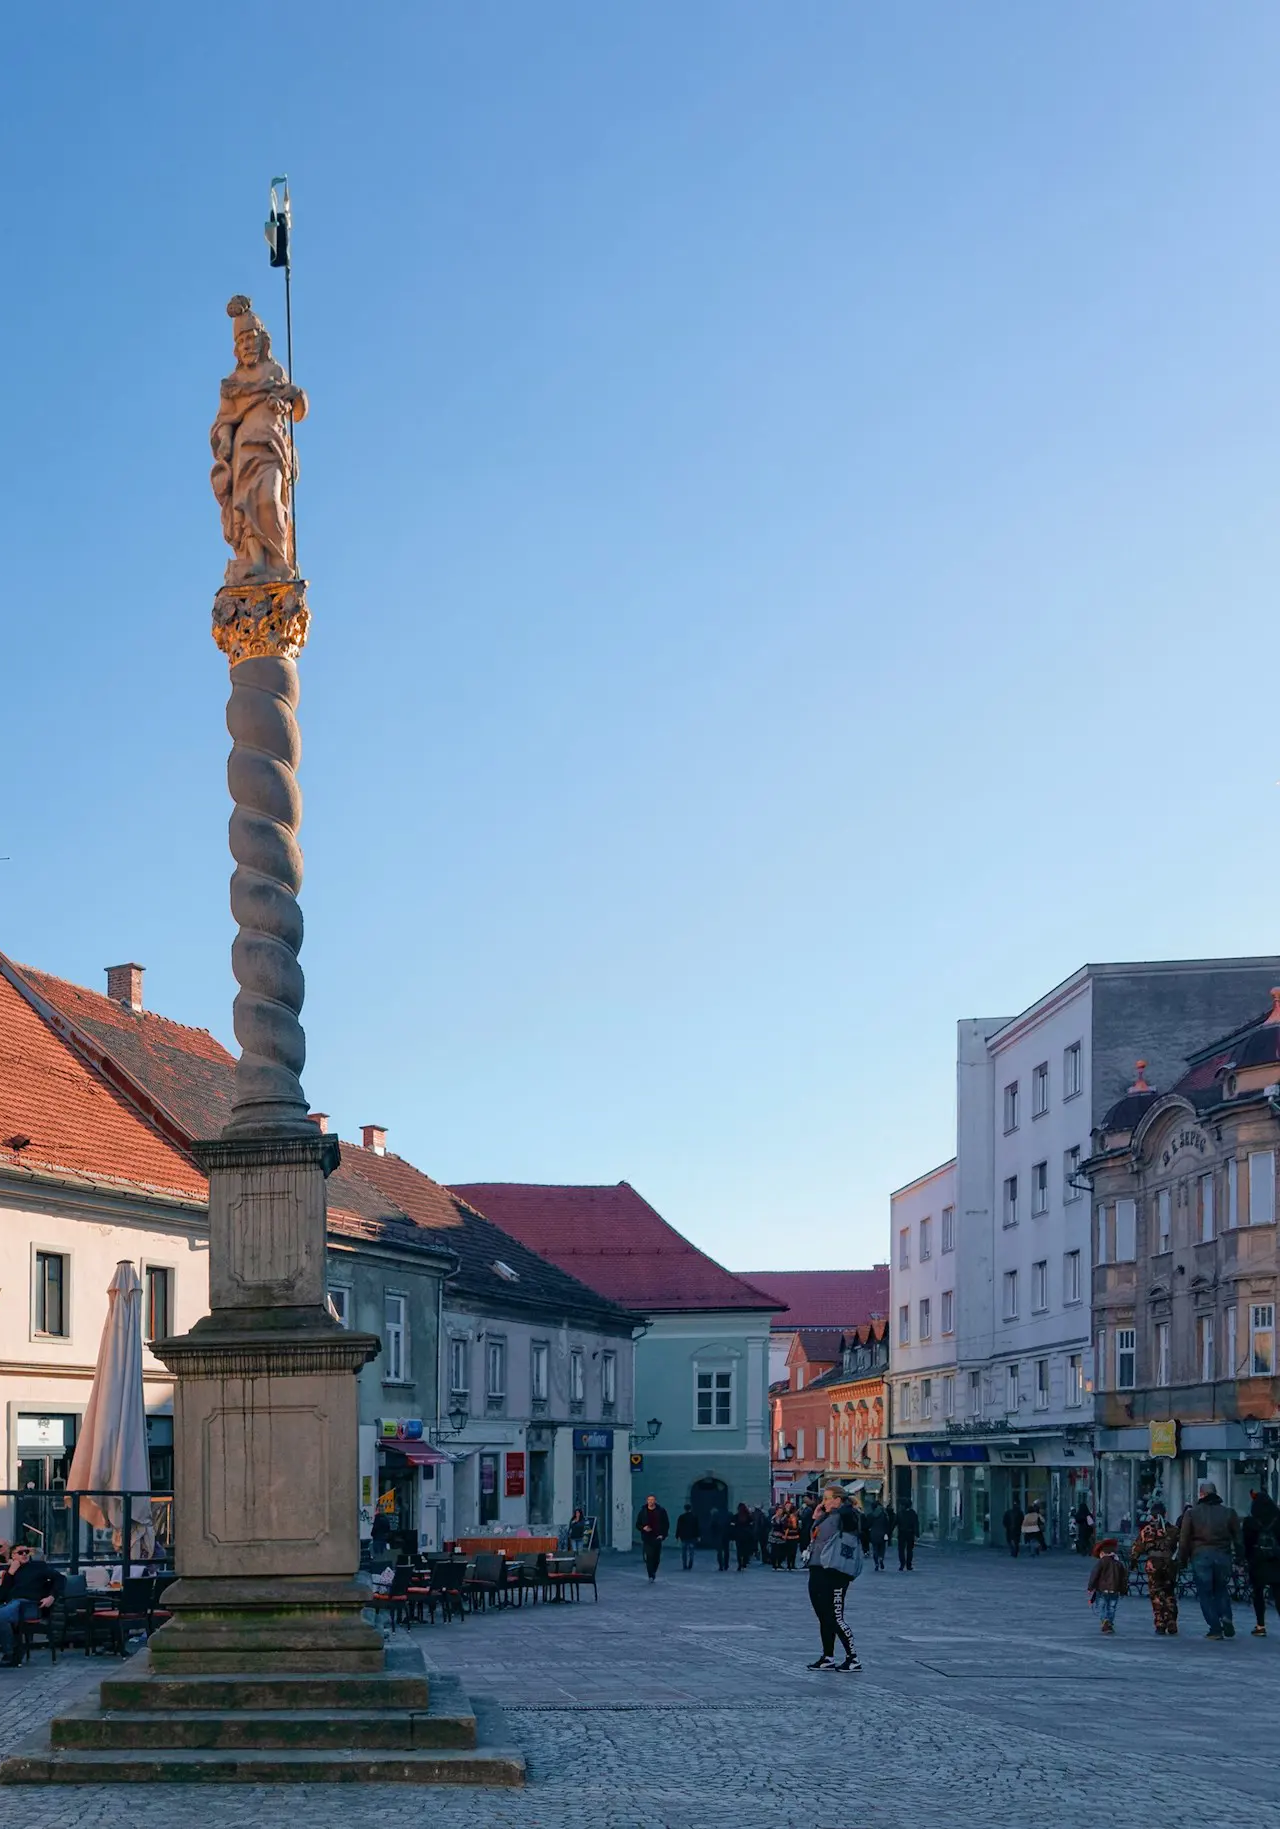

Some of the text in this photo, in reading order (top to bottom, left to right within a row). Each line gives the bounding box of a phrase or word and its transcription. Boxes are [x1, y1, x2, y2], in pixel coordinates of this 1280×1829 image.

[834, 1588, 843, 1603] THE
[834, 1603, 847, 1631] FUTURE
[844, 1627, 852, 1638] IS
